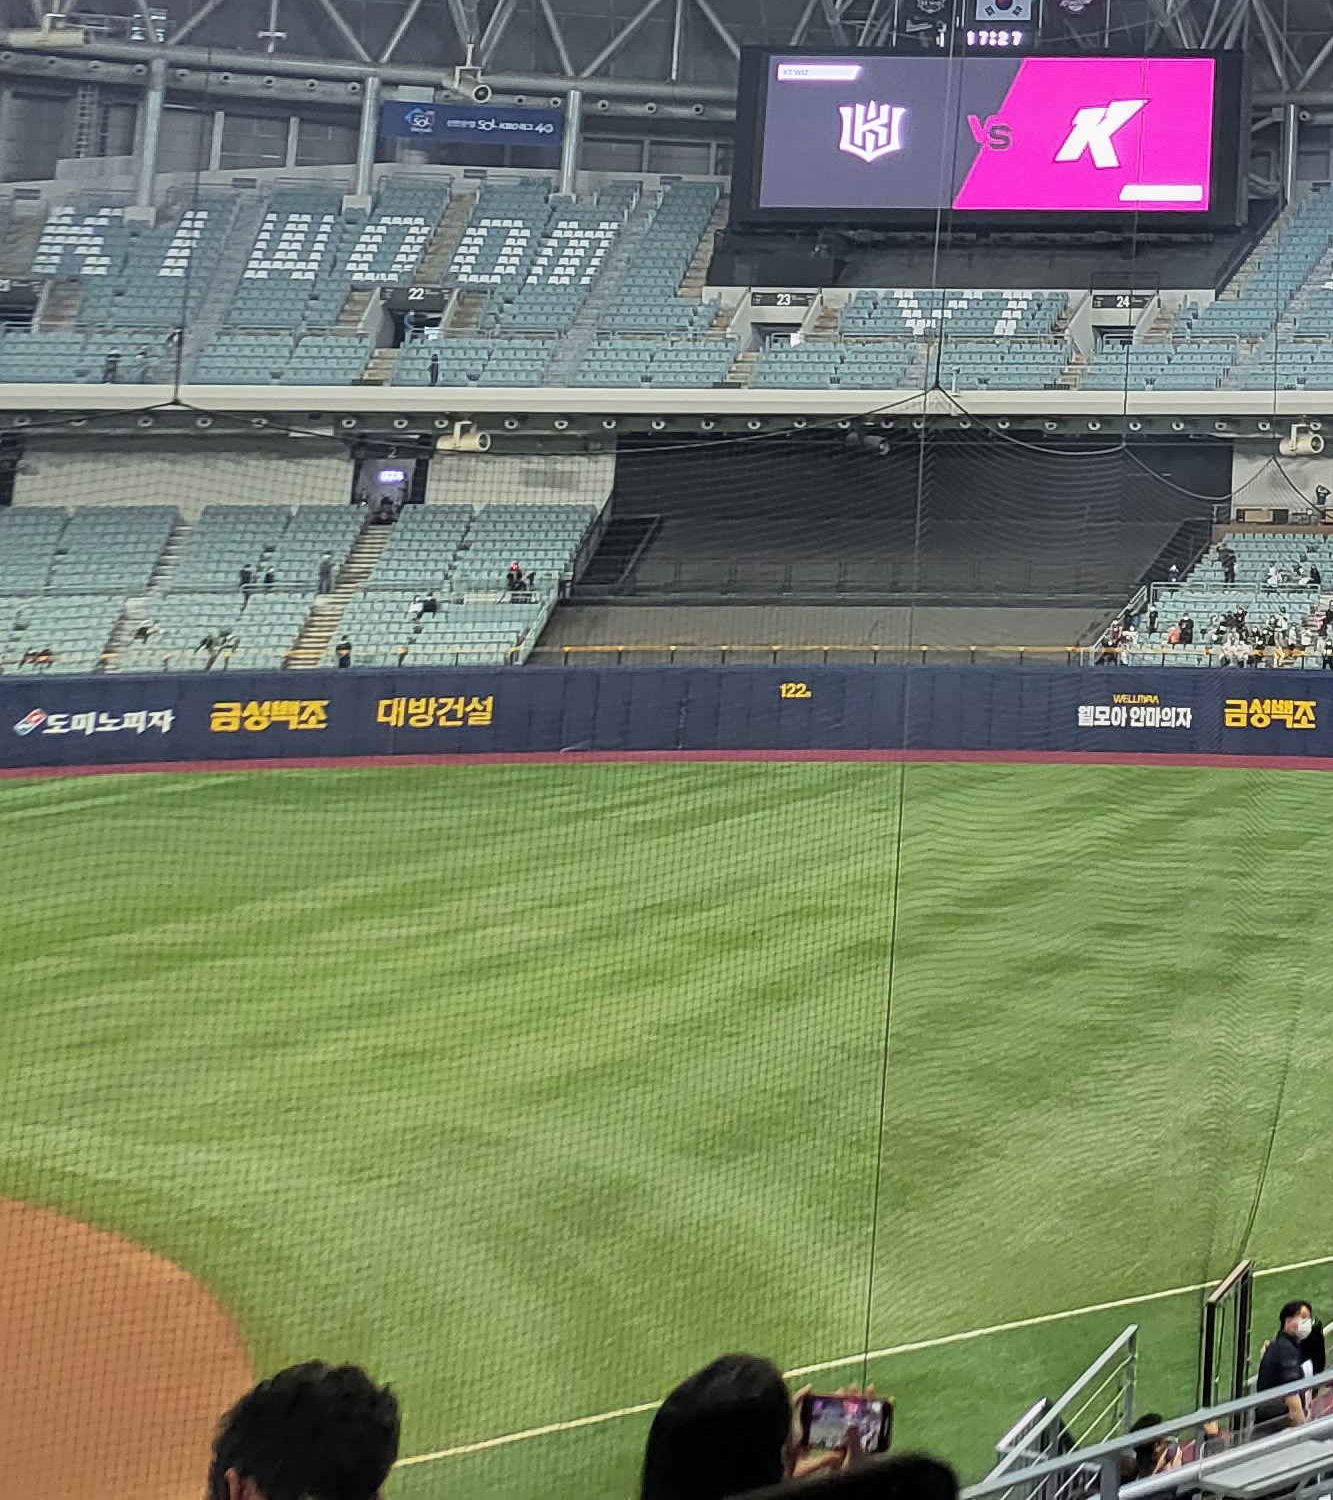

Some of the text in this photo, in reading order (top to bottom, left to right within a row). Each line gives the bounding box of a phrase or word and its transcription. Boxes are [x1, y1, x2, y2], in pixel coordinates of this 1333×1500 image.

[966, 30, 1023, 47] 17:27
[407, 287, 424, 301] 22
[776, 293, 791, 306] 23
[1115, 295, 1130, 308] 24
[387, 446, 397, 458] 2
[42, 708, 175, 736] 도미노피자
[209, 699, 329, 733] 금성백조
[375, 695, 494, 729] 대방건설
[1130, 706, 1192, 729] 안마의자
[1224, 698, 1317, 730] 금성백조
